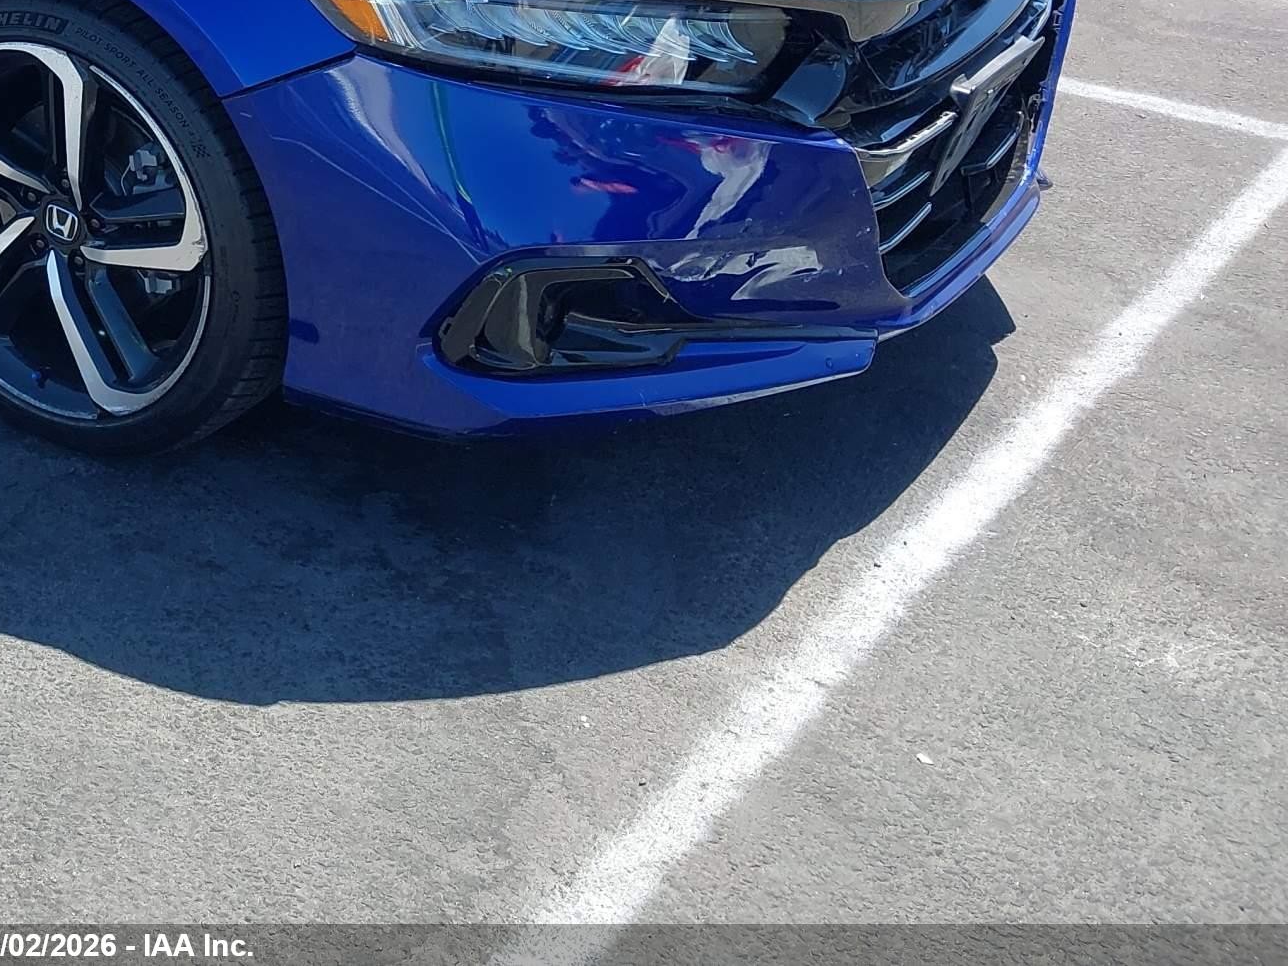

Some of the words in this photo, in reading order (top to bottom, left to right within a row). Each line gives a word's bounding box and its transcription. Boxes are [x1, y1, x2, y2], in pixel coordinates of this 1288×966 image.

[75, 26, 103, 46] PILOT
[103, 42, 137, 68] SPORT
[136, 68, 153, 87] ALL
[155, 87, 190, 129] SEASON
